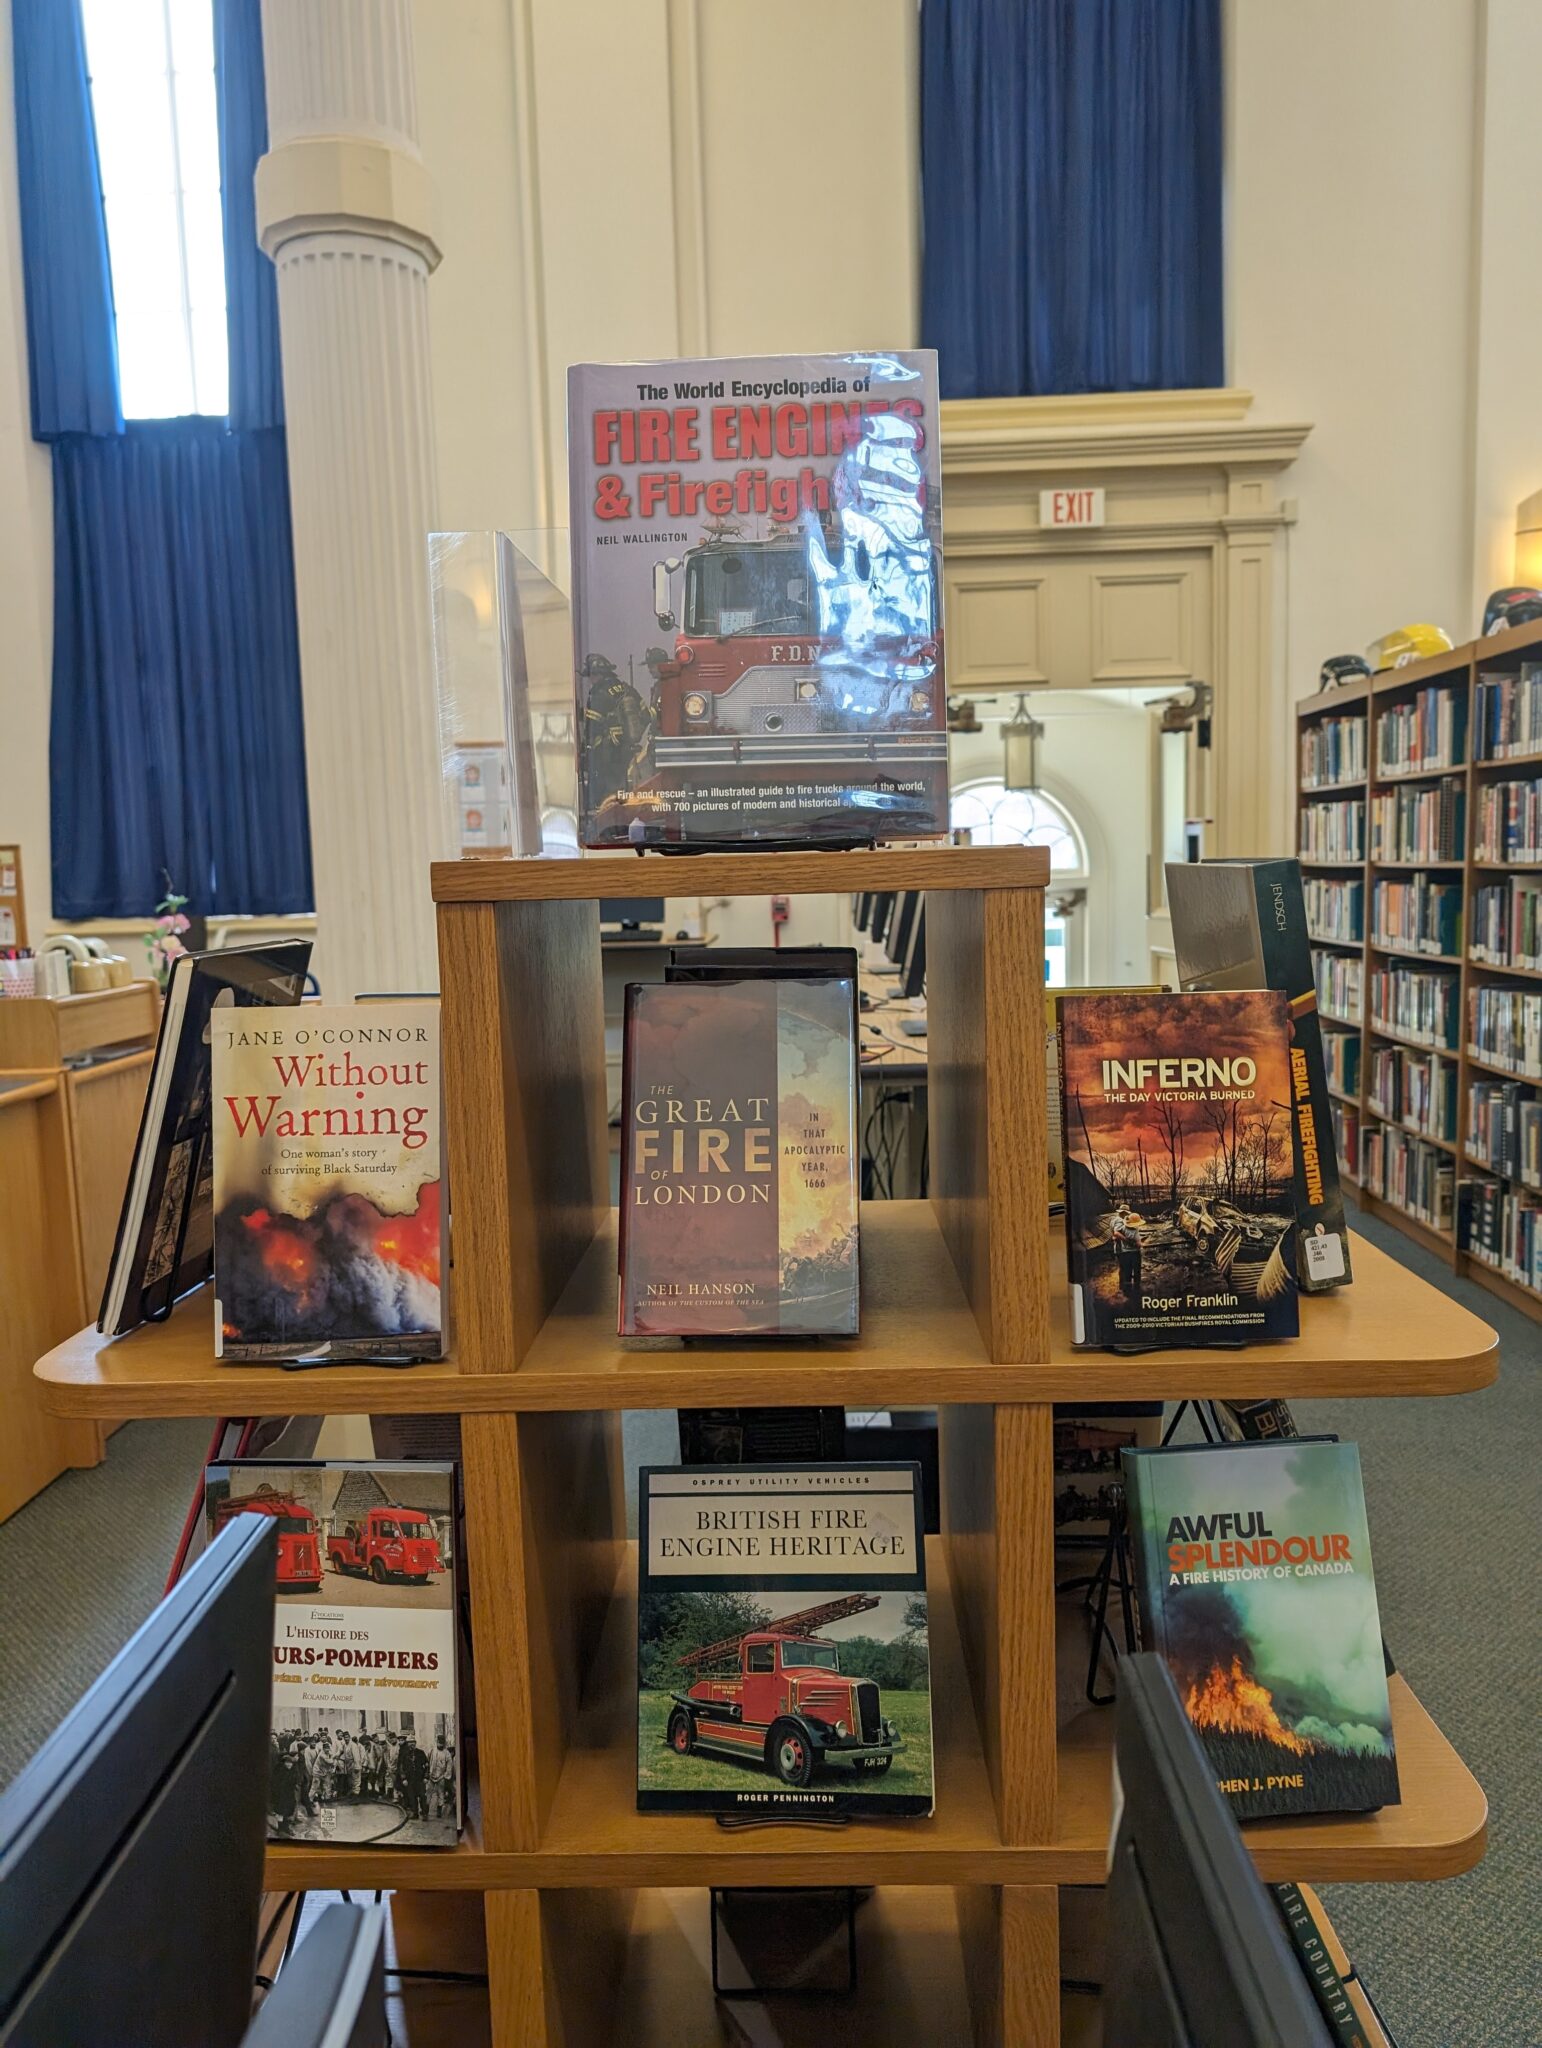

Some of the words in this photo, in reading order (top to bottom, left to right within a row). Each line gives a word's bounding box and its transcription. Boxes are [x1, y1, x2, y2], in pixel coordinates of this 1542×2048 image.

[637, 384, 668, 400] The
[674, 382, 724, 399] World
[732, 378, 846, 400] Encyclopedia
[853, 376, 870, 392] of
[593, 408, 700, 465] FIRE
[594, 473, 632, 520] &
[639, 468, 927, 522] Firefigh
[1053, 491, 1095, 523] EXIT
[596, 535, 619, 546] NEIL
[622, 532, 688, 545] WALLINGTON
[617, 790, 634, 799] Fire
[637, 790, 654, 799] and
[656, 790, 686, 799] rescue
[697, 790, 708, 798] an
[711, 786, 756, 797] illustrated
[759, 785, 783, 797] guide
[786, 785, 795, 795] to
[797, 784, 813, 795] fire
[815, 783, 843, 794] trucks
[880, 781, 894, 792] the
[897, 781, 926, 793] world,
[651, 802, 671, 812] with
[674, 802, 690, 812] 700
[692, 801, 729, 813] pictures
[731, 800, 741, 810] of
[743, 799, 777, 810] modern
[779, 798, 796, 809] and
[799, 796, 841, 808] historical
[1269, 883, 1287, 932] JENDSCH
[228, 1030, 284, 1049] JANE
[295, 1028, 429, 1045] O'CONNOR
[272, 1051, 429, 1088] Without
[1102, 1056, 1257, 1090] INFERNO
[1290, 1048, 1310, 1101] AERIAL
[650, 1085, 674, 1095] THE
[1104, 1093, 1127, 1103] THE
[1129, 1092, 1151, 1102] DAY
[1154, 1091, 1207, 1102] VICTORIA
[1210, 1090, 1256, 1100] BURNED
[223, 1091, 429, 1149] Warning
[635, 1098, 769, 1124] GREAT
[809, 1112, 819, 1122] IN
[803, 1128, 826, 1139] THAT
[281, 1149, 303, 1159] One
[305, 1148, 350, 1159] woman's
[352, 1148, 377, 1160] story
[634, 1127, 772, 1175] FIRE
[784, 1145, 846, 1156] APOCALYPTIC
[1298, 1104, 1324, 1206] FIREFIGHTING
[261, 1165, 273, 1175] of
[274, 1165, 321, 1177] surviving
[323, 1163, 351, 1174] Black
[353, 1163, 398, 1175] Saturday
[651, 1170, 669, 1181] OF
[801, 1162, 829, 1174] YEAR,
[804, 1178, 826, 1189] 1666
[634, 1184, 770, 1205] LONDON
[647, 1284, 682, 1295] NEIL
[689, 1283, 755, 1295] HANSON
[1142, 1296, 1182, 1311] Roger
[1186, 1293, 1238, 1308] Franklin
[1198, 1313, 1249, 1321] RECOMMENDATIONS
[692, 1478, 741, 1486] OSPREY
[750, 1477, 799, 1485] UTILITY
[808, 1476, 871, 1485] VEHICLES
[696, 1509, 801, 1531] BRITISH
[810, 1509, 867, 1530] FIRE
[1165, 1511, 1273, 1544] AWFUL
[660, 1537, 760, 1558] ENGINE
[769, 1535, 905, 1556] HERITAGE
[1167, 1533, 1353, 1573] SPLENDOUR
[1169, 1573, 1181, 1586] A
[1183, 1572, 1210, 1585] FIRE
[1213, 1567, 1272, 1583] HISTORY
[1273, 1565, 1292, 1578] OF
[1295, 1562, 1355, 1577] CANADA
[286, 1625, 347, 1640] L'HISTOIRE
[350, 1630, 369, 1641] DES
[302, 1692, 330, 1701] ROLAND
[1217, 1778, 1250, 1793] HEN
[1252, 1777, 1264, 1791] J.
[1266, 1774, 1305, 1790] PYNE
[737, 1794, 769, 1803] ROGER
[773, 1794, 835, 1803] PENNINGTON
[1278, 1882, 1309, 1928] FIRE
[1303, 1937, 1353, 2025] COUNTRY
